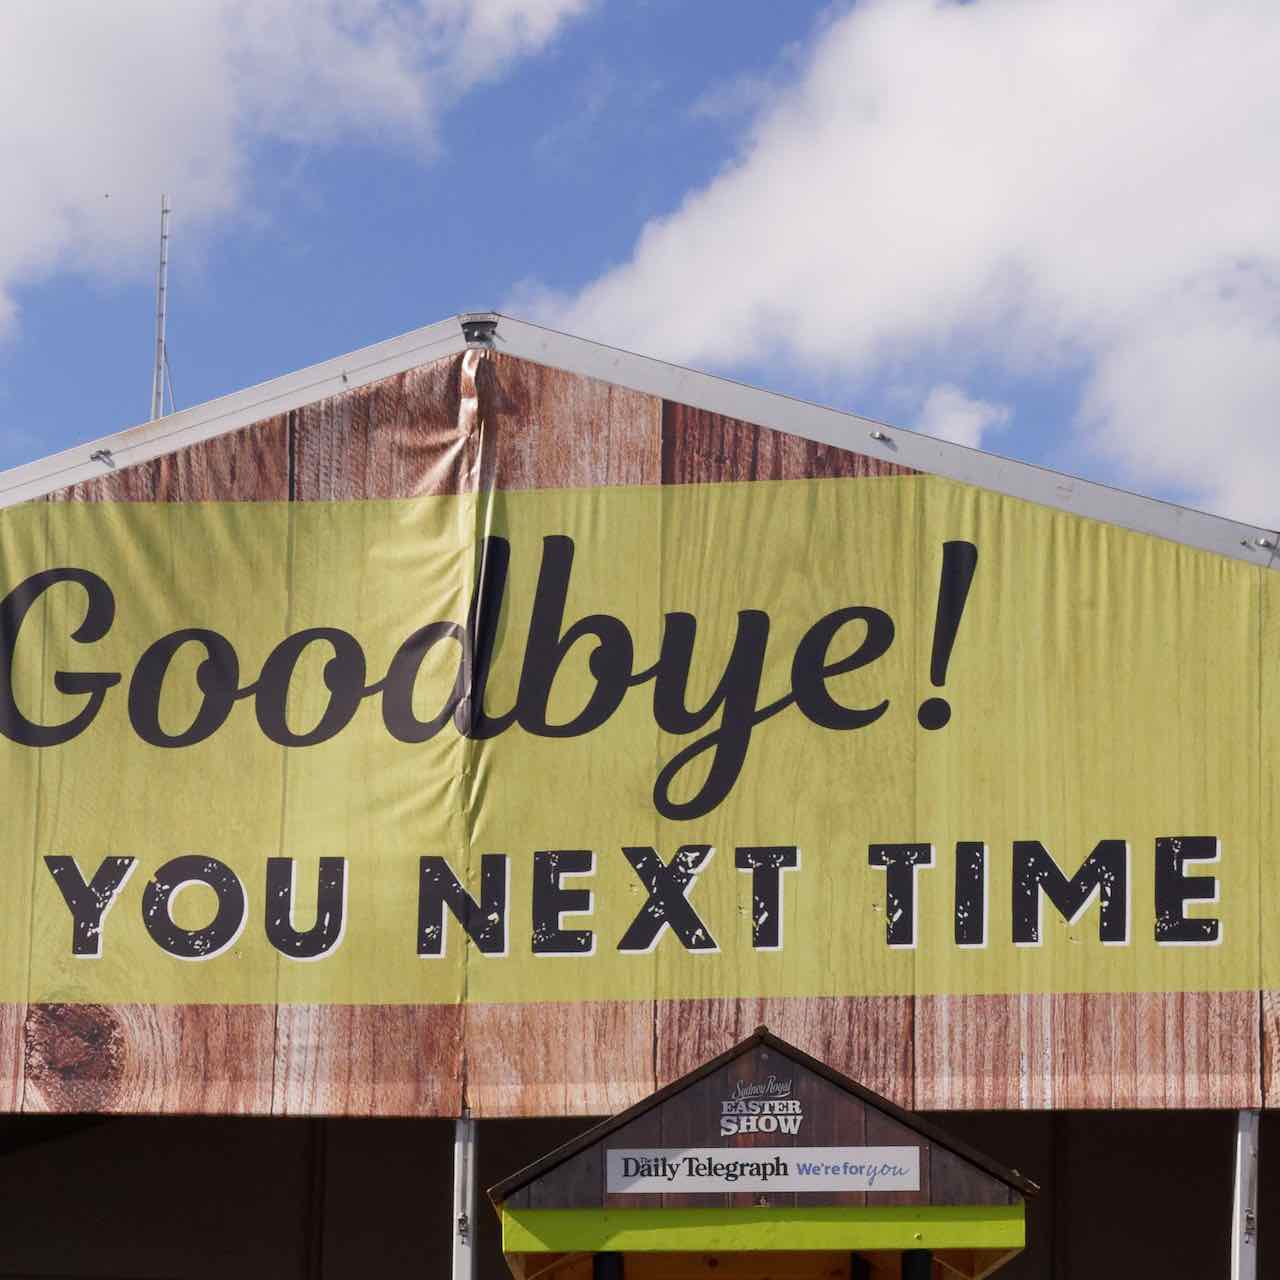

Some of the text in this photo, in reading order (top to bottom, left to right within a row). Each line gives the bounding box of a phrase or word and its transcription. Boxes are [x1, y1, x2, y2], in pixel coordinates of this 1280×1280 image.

[44, 853, 349, 962] YOU
[417, 843, 801, 959] NEXT
[868, 835, 1223, 951] TIME
[721, 1100, 802, 1114] EASTER
[721, 1115, 803, 1136] SHOW
[622, 1157, 680, 1181] Daily
[682, 1156, 789, 1181] Telegraph
[797, 1162, 841, 1175] We're
[843, 1161, 865, 1175] for
[865, 1165, 910, 1186] you
